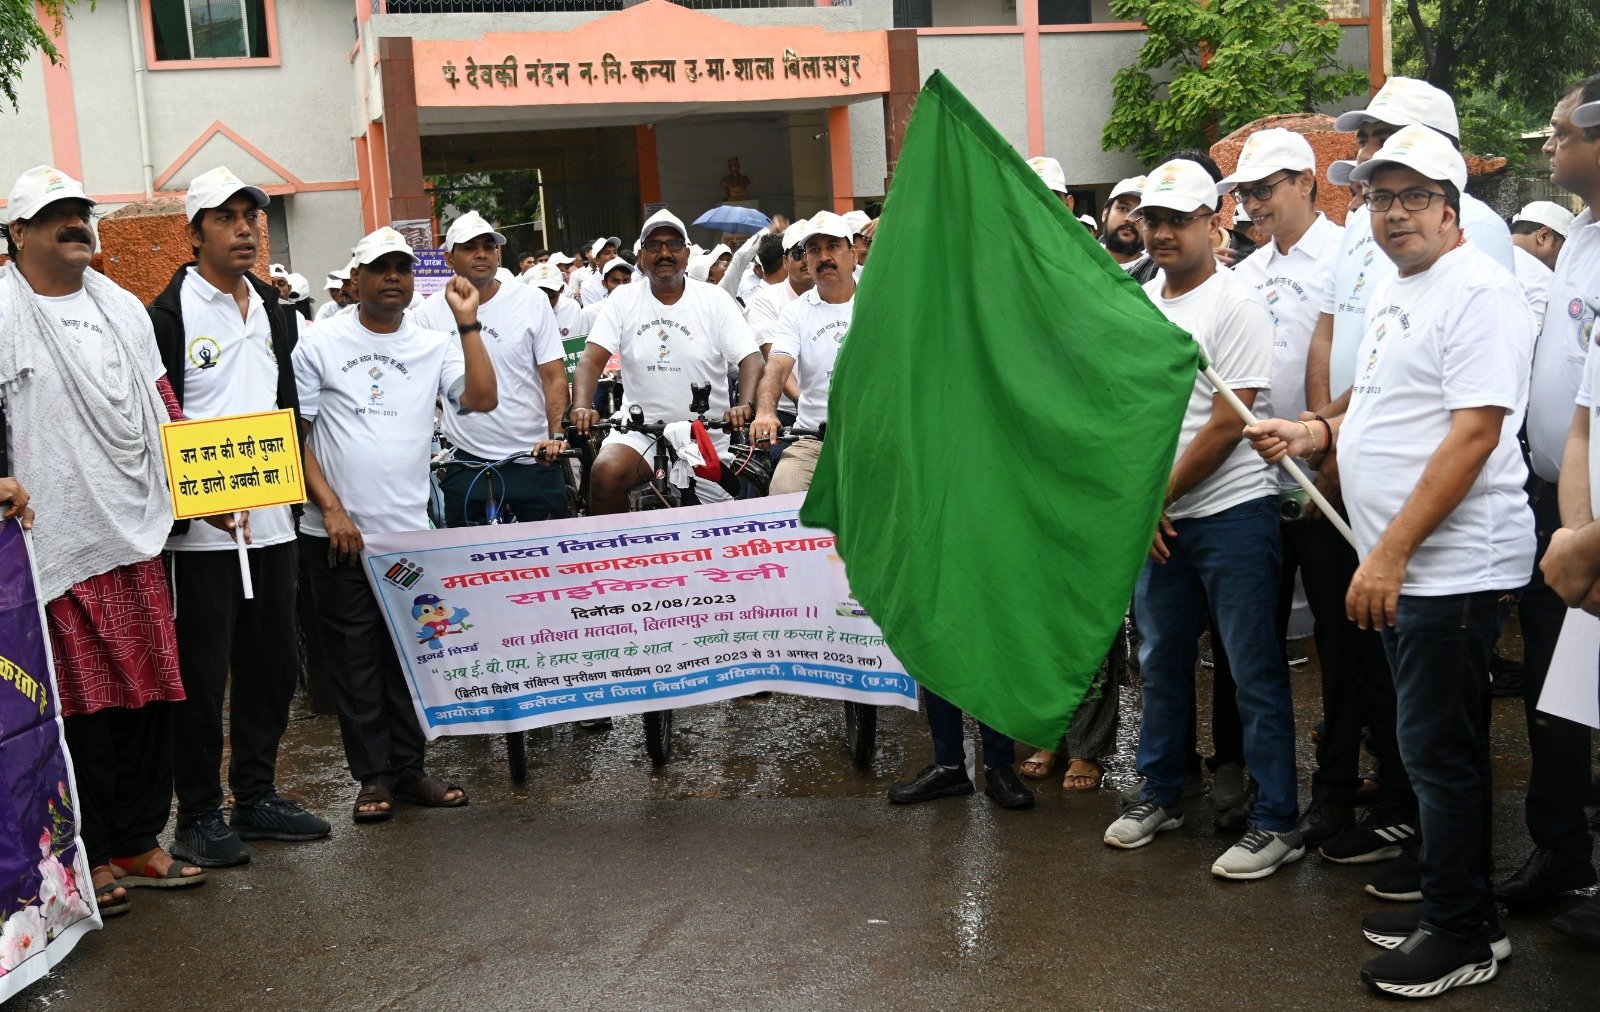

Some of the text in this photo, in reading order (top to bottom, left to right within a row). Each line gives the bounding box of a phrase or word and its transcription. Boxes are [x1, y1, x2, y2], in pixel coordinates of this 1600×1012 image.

[466, 55, 518, 89] देवकी
[525, 58, 570, 87] नंदन
[782, 48, 860, 87] बिलासपुर
[180, 435, 285, 463] जन जन की यही पुकार
[179, 474, 198, 496] वोट
[201, 470, 226, 494] डालो
[230, 466, 260, 490] अबकी
[263, 468, 280, 485] बार
[470, 518, 798, 562] भारत निर्वाचन आयोग
[441, 566, 549, 589] मतदाता
[556, 547, 712, 576] जागरूकता
[722, 536, 837, 559] अभियान
[506, 563, 788, 605] साइकिल रैली
[631, 594, 736, 613] 02/08/2023
[502, 635, 525, 648] शत
[530, 628, 579, 647] प्रतिशत
[584, 621, 638, 637] मतदान,
[643, 613, 709, 632] बिलासपुर
[714, 611, 733, 622] का
[740, 605, 798, 621] अभिमान
[443, 667, 468, 681] अब
[537, 651, 546, 669] हे
[550, 652, 579, 668] हमर
[582, 648, 620, 667] चुनाव
[624, 641, 639, 657] के
[643, 641, 673, 656] शान
[733, 630, 759, 645] झन
[763, 629, 780, 641] ला
[784, 629, 823, 642] करना
[827, 626, 836, 643] हे
[840, 631, 886, 648] मतदान
[492, 682, 520, 695] विशेष
[524, 676, 559, 690] संक्षिप्त
[563, 670, 607, 687] पुनरीक्षण
[611, 665, 651, 680] कार्यक्रम
[655, 664, 672, 674] 02
[677, 656, 710, 671] अगस्त
[714, 651, 748, 665] 2023
[751, 648, 762, 659] से
[767, 650, 781, 658] 31
[786, 650, 818, 660] अगस्त
[823, 652, 854, 664] 2023
[857, 655, 882, 669] तक)
[435, 705, 495, 719] आयोजक
[518, 693, 577, 710] कलेक्टर
[583, 687, 605, 701] एवं
[610, 685, 647, 698] जिला
[653, 675, 709, 694] निर्वाचन
[792, 664, 854, 684] बिलासपुर
